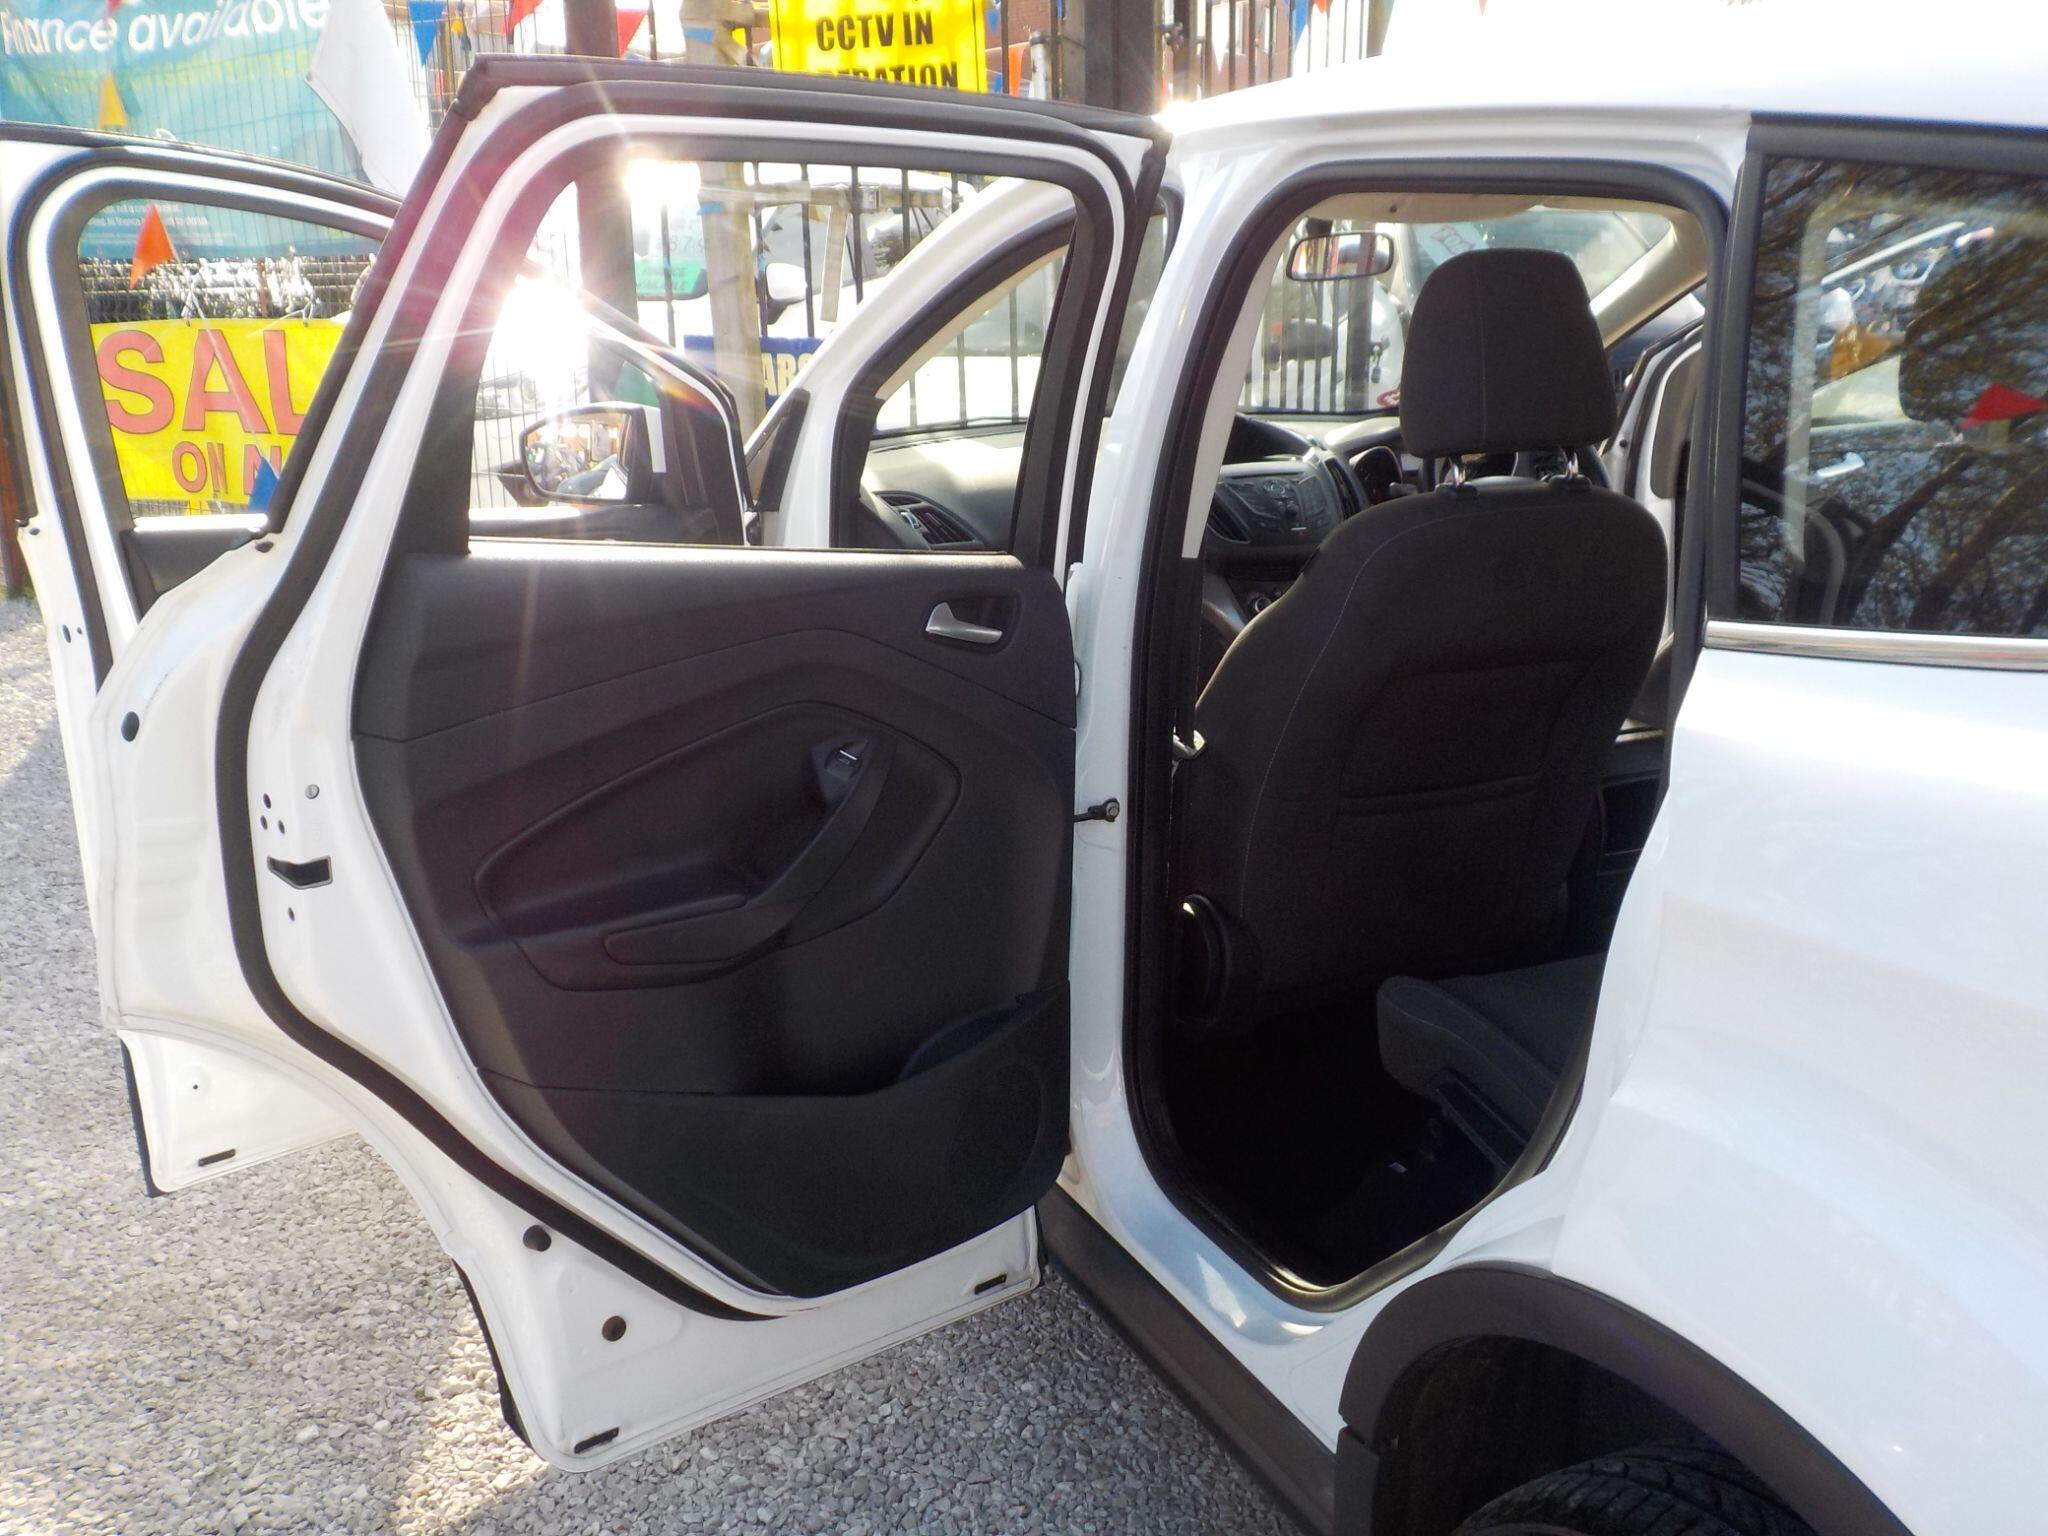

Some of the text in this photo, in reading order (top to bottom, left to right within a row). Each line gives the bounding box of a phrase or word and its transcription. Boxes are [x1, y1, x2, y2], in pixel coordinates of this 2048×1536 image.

[816, 10, 935, 51] CCTV IN
[172, 441, 228, 494] ON
